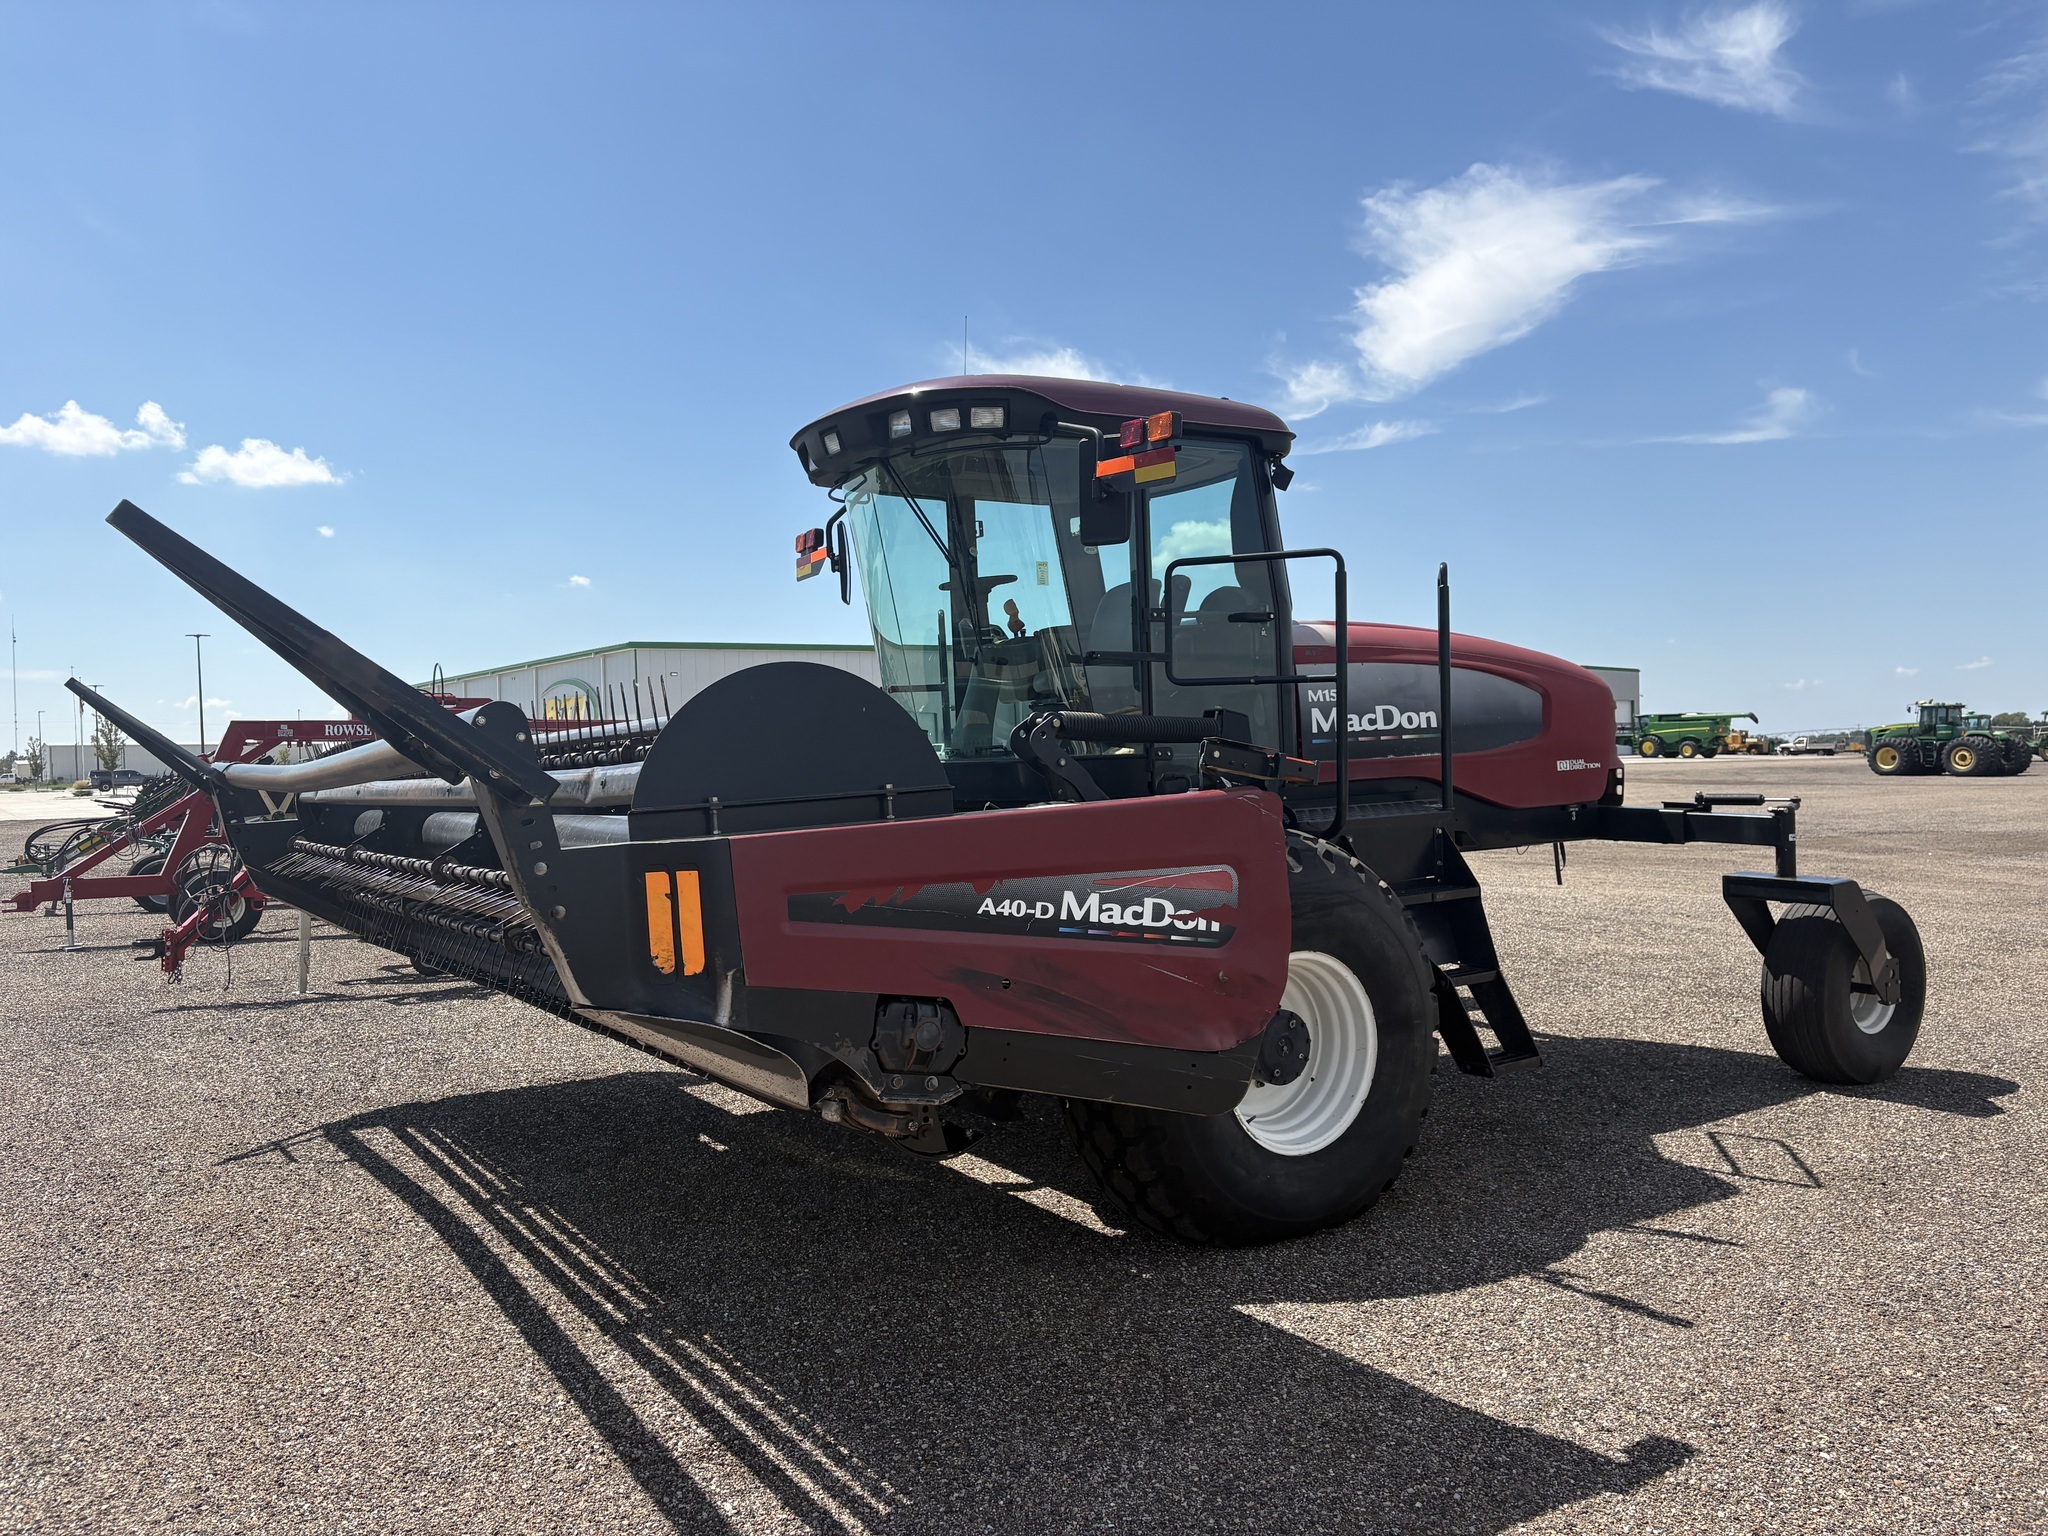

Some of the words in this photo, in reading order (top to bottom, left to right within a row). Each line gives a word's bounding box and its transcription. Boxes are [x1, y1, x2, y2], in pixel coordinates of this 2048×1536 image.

[1307, 688, 1337, 703] M15
[1311, 704, 1438, 734] MacDon
[976, 897, 1055, 919] A40-D
